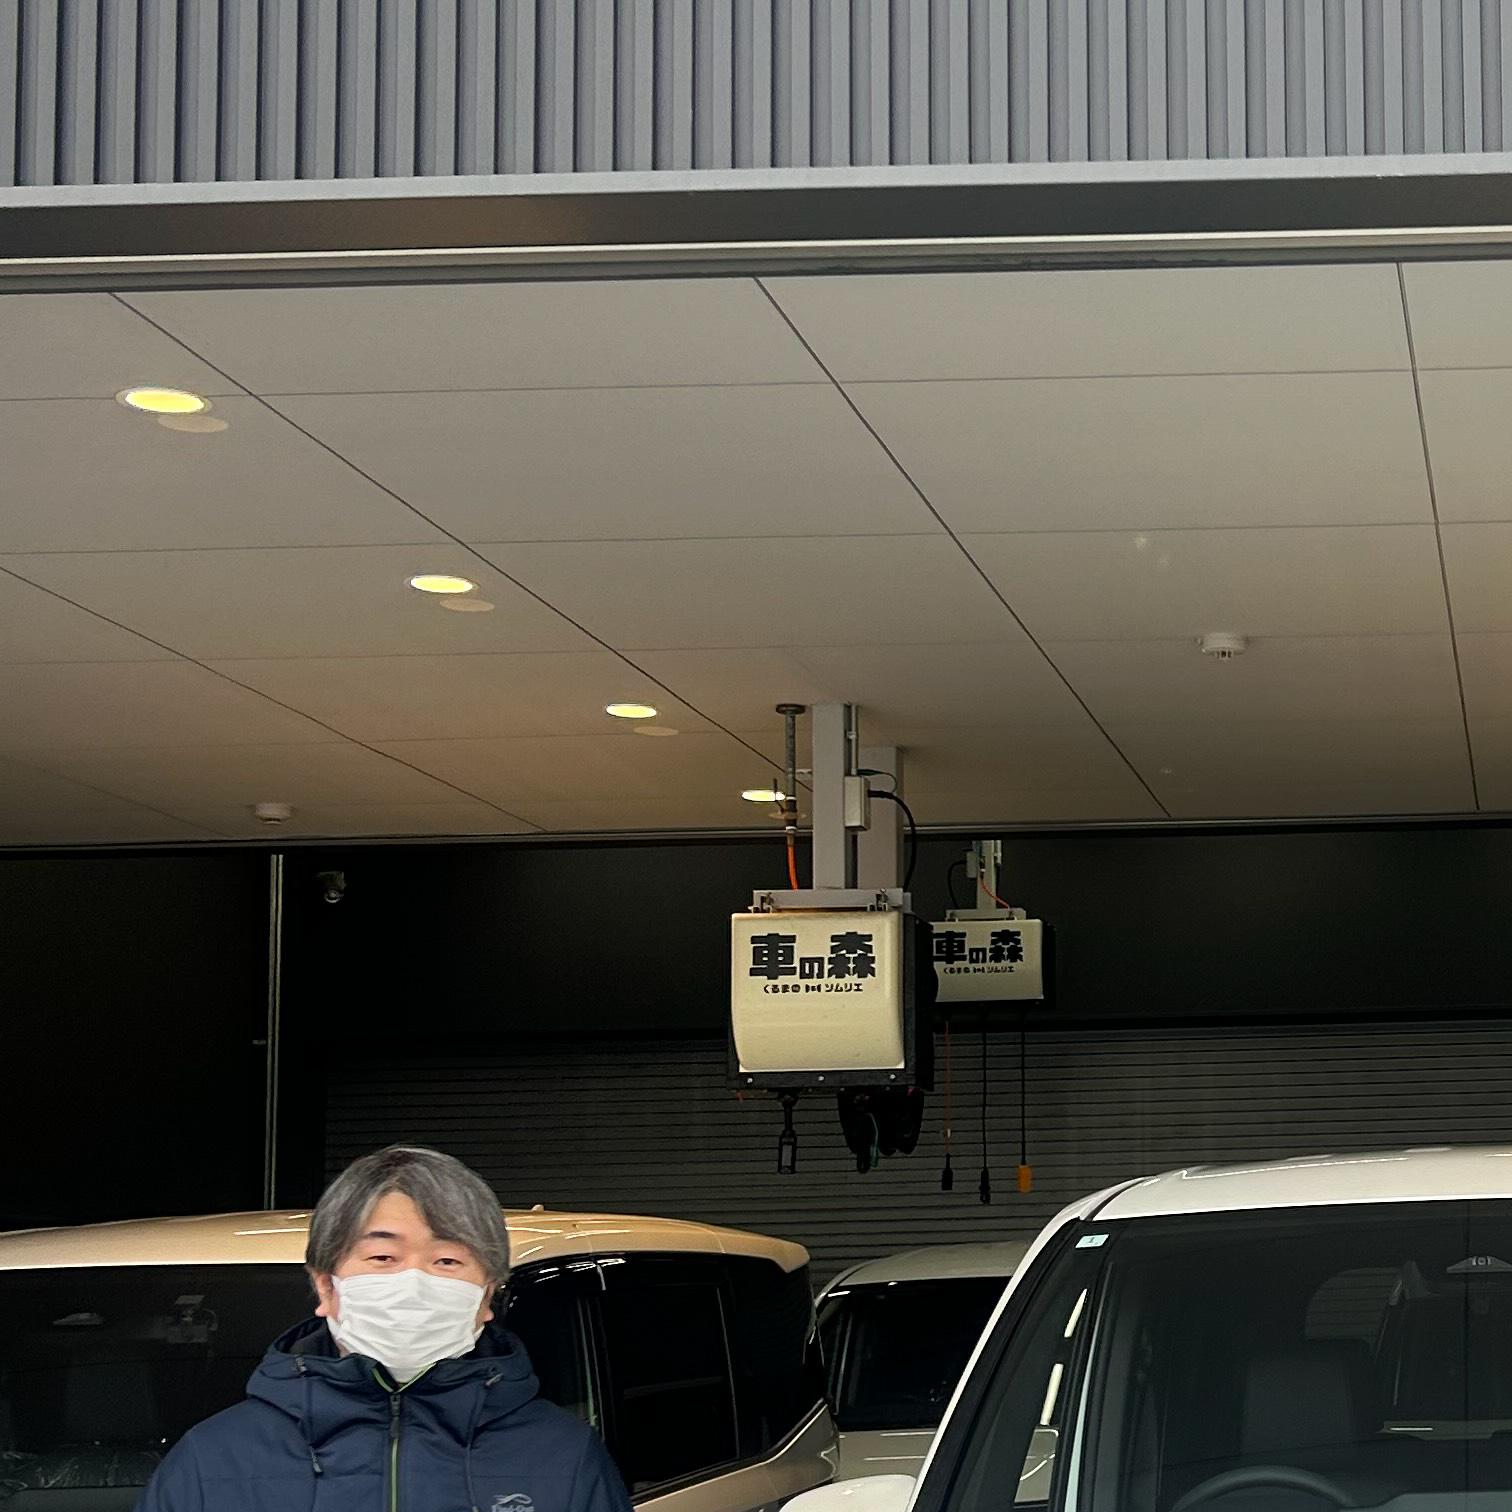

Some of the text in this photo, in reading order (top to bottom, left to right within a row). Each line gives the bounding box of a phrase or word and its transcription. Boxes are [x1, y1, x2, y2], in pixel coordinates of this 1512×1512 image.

[749, 931, 876, 980] 車の森
[932, 929, 1024, 964] 車の森
